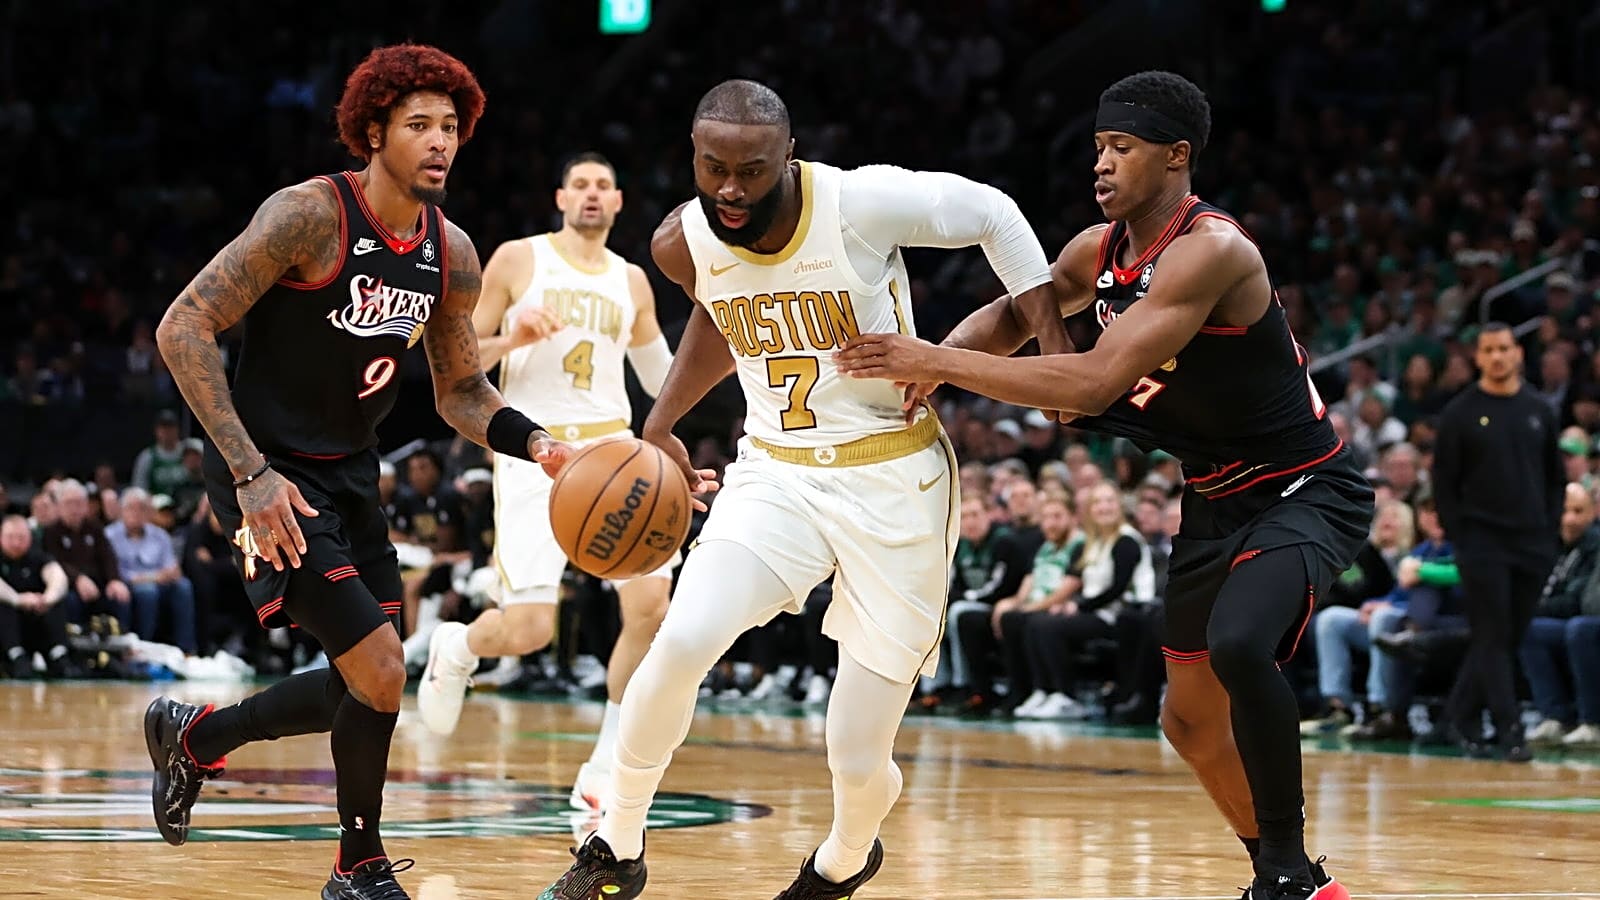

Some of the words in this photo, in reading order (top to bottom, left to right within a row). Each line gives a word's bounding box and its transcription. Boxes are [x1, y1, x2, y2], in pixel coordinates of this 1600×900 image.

[357, 237, 377, 250] NIKE
[793, 259, 833, 275] Amica
[543, 287, 624, 343] BOSTON
[711, 290, 861, 358] BOSTON
[357, 356, 397, 400] 9
[562, 339, 595, 392] 4
[765, 355, 820, 432] 7
[585, 476, 652, 561] Wilson
